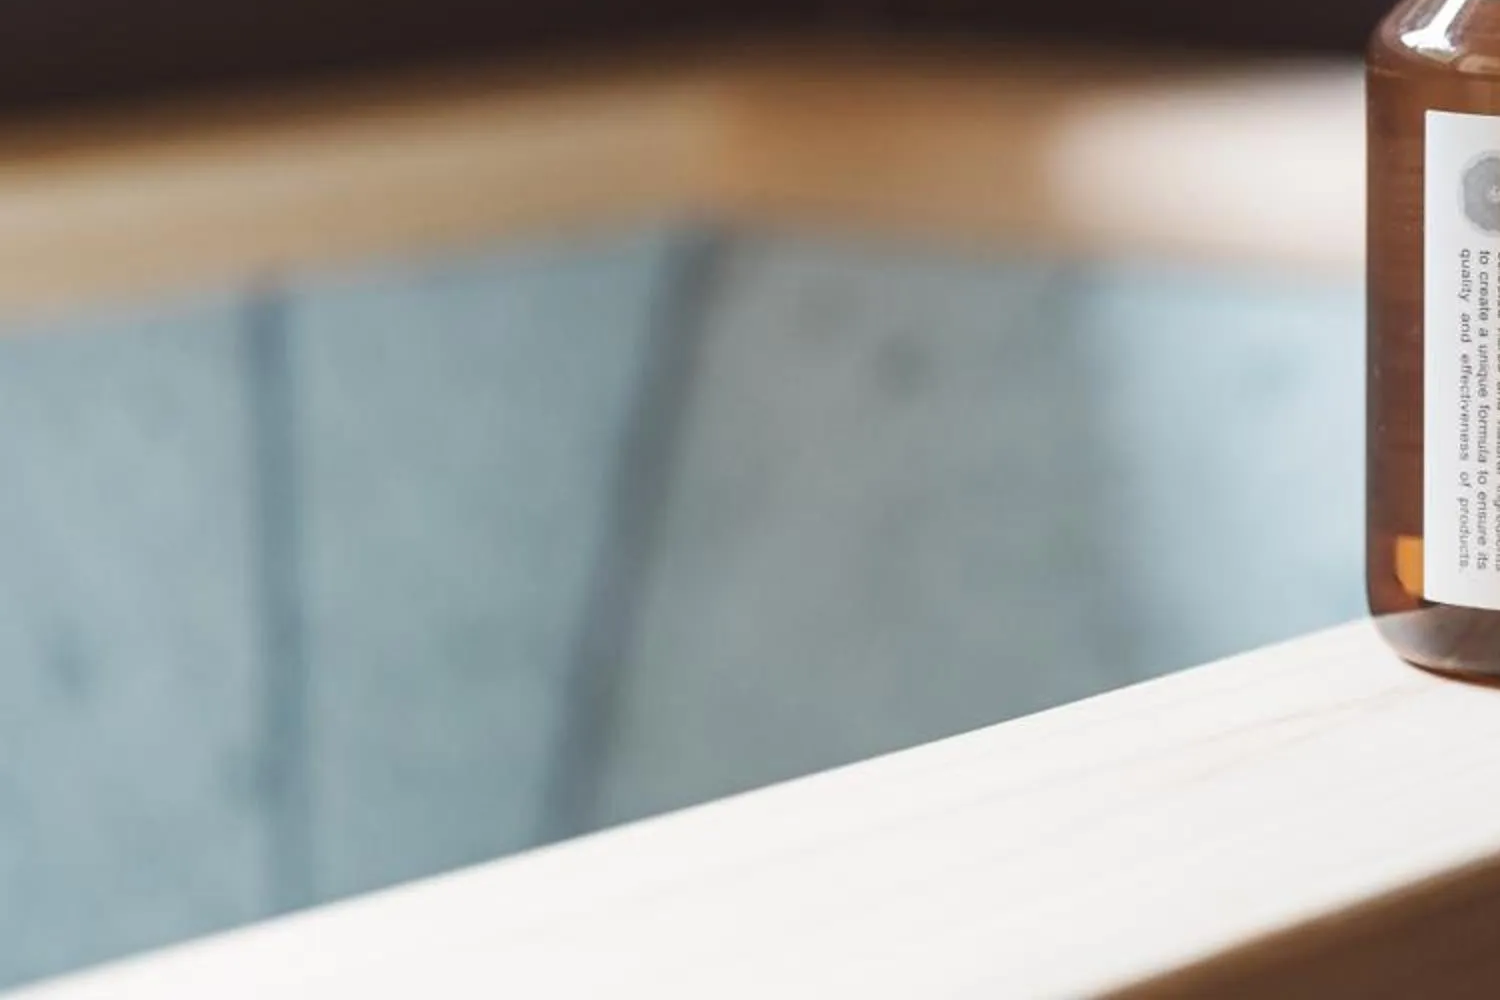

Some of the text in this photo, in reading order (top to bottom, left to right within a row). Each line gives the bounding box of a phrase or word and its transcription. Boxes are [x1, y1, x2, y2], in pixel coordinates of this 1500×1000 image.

[1458, 249, 1472, 301] quality
[1461, 313, 1472, 343] and
[1459, 354, 1472, 460] effectiveness
[1474, 250, 1490, 570] to create a unique formula to ensure its
[1459, 472, 1472, 488] of
